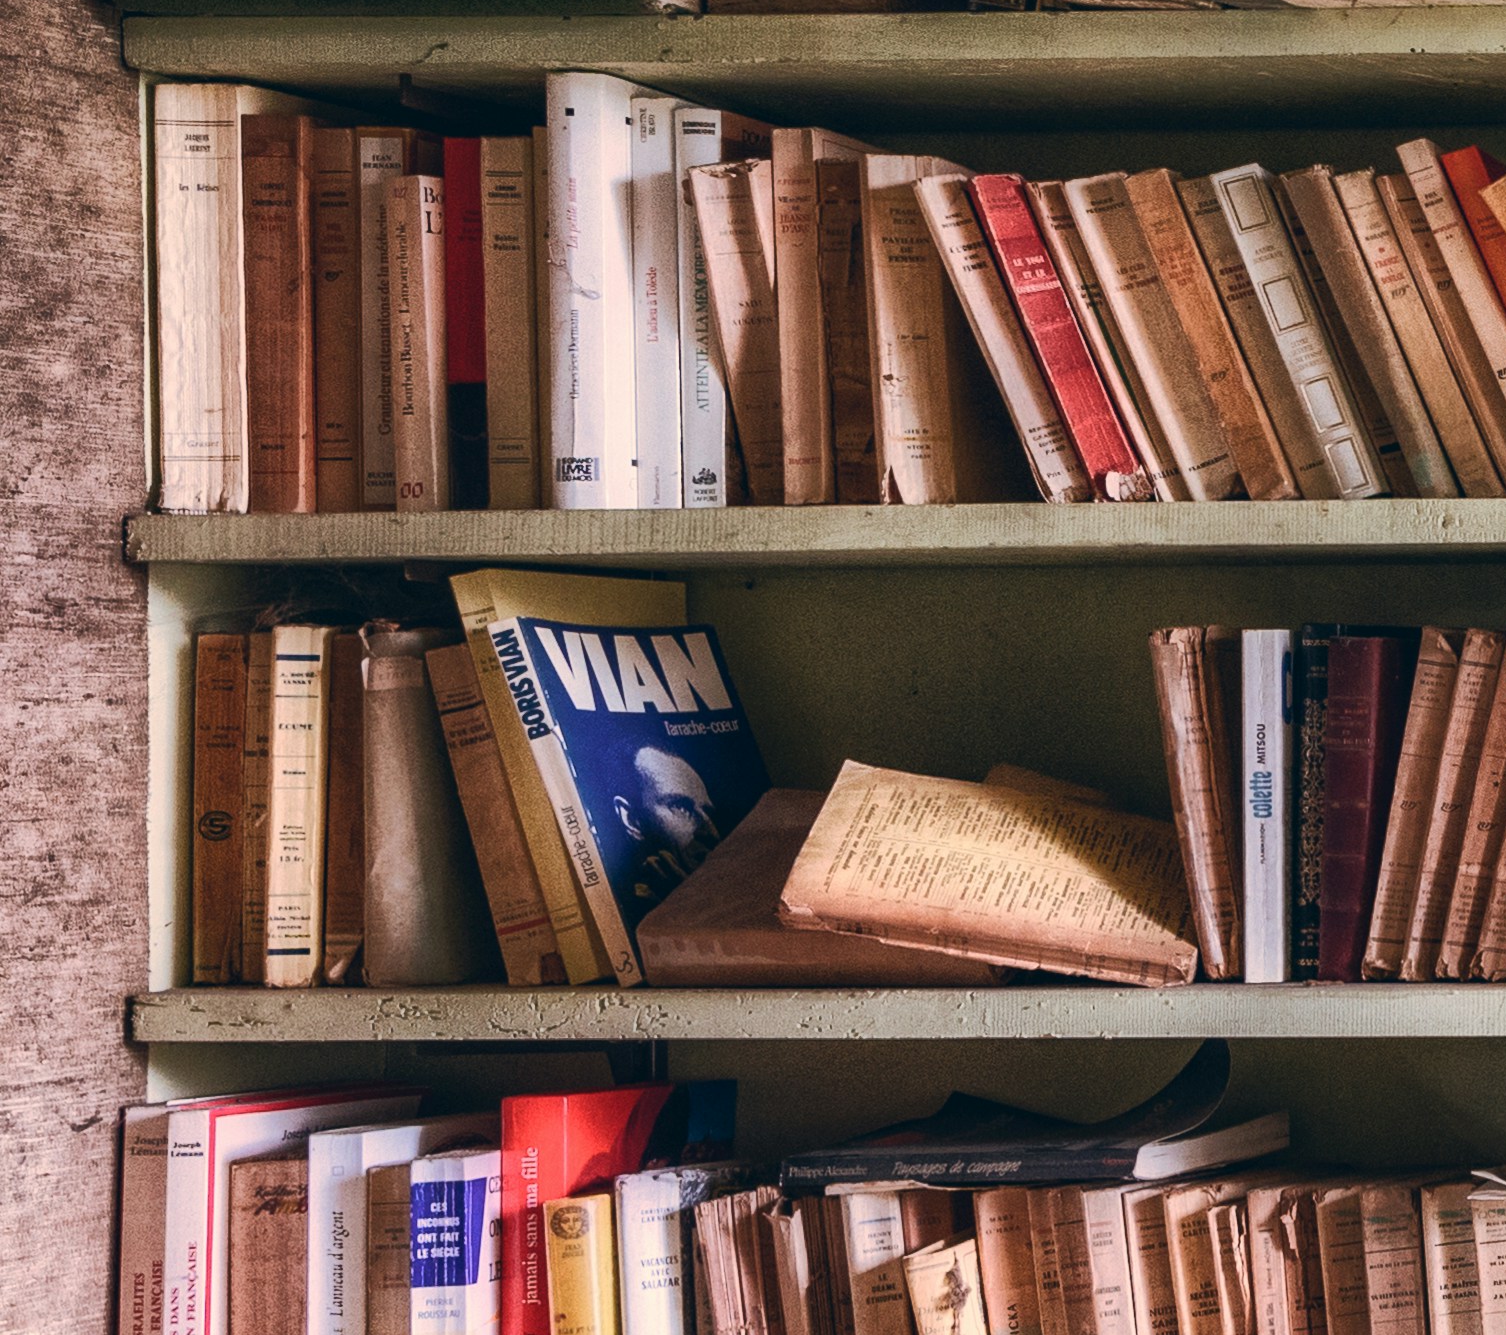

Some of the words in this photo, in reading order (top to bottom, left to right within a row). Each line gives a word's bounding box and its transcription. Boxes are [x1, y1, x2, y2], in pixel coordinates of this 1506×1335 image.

[646, 267, 659, 297] Tolède
[646, 308, 658, 343] L'adieu
[492, 629, 532, 687] VIAN
[533, 626, 732, 714] VIAN
[514, 686, 551, 740] BORIS
[1256, 724, 1266, 764] MITSOU
[1251, 771, 1273, 819] colette
[521, 1147, 538, 1180] fille
[524, 1184, 538, 1208] ma
[524, 1213, 538, 1248] sans
[185, 1241, 200, 1321] FRANÇAISE
[523, 1253, 540, 1305] jamais
[170, 1287, 179, 1325] DANS
